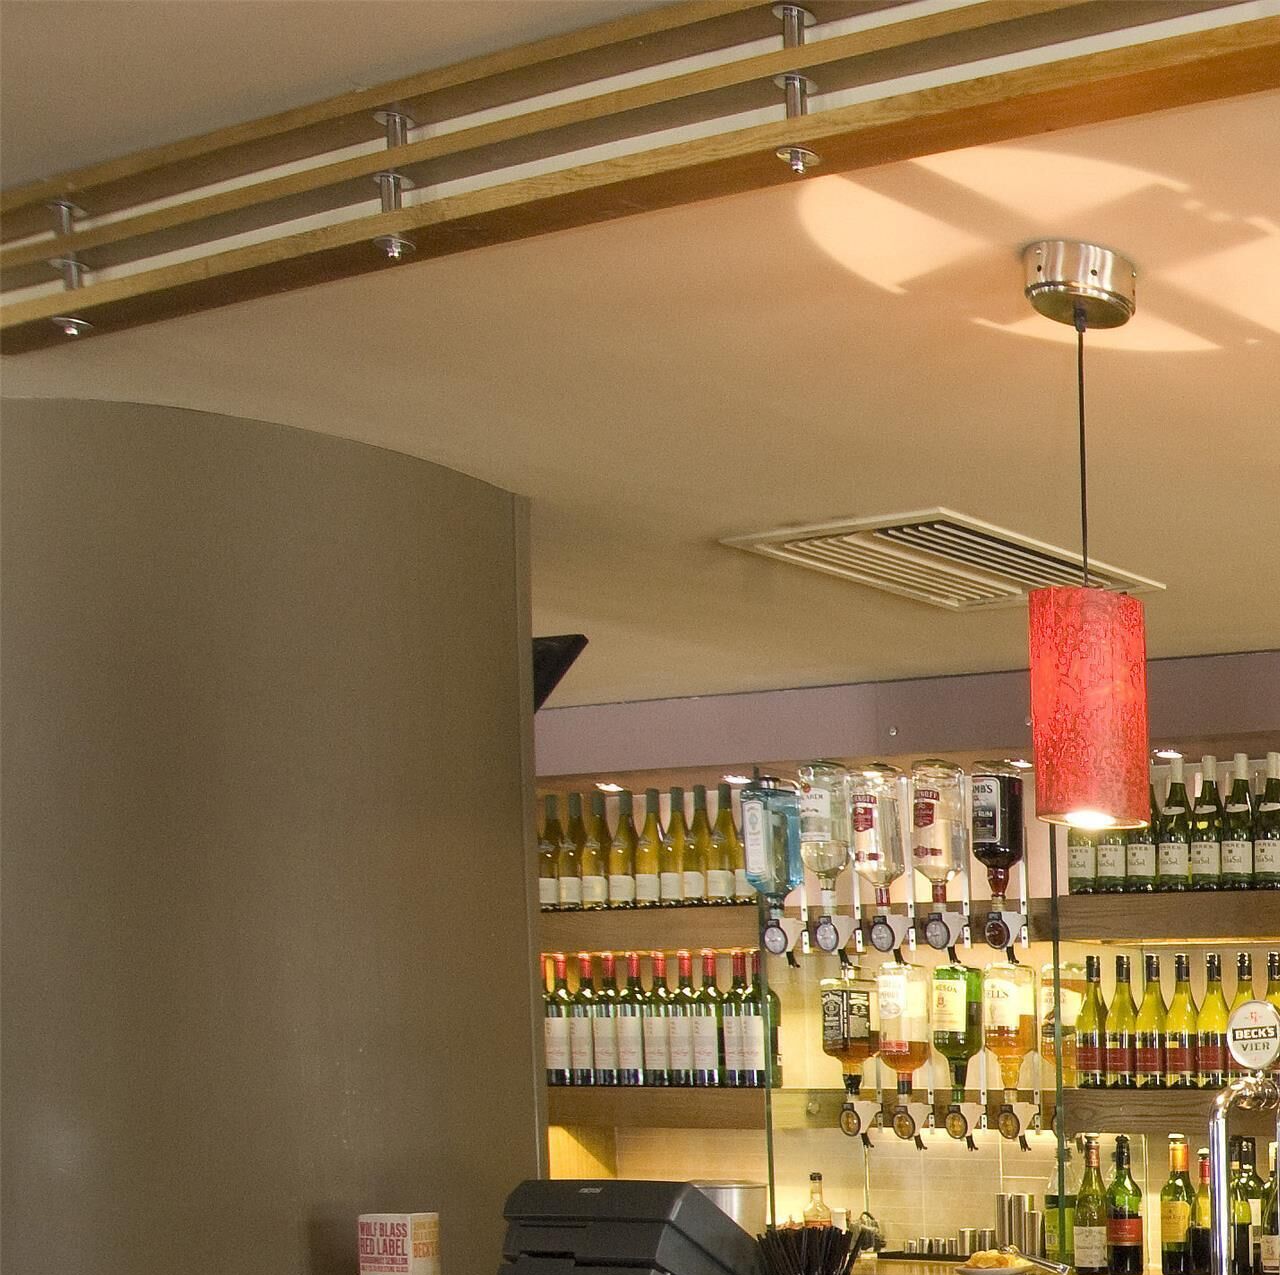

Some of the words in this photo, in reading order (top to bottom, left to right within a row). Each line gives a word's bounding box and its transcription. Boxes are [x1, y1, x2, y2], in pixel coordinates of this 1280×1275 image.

[1234, 1026, 1275, 1040] BECK'S
[1241, 1042, 1270, 1052] VIER
[359, 1221, 378, 1237] WOLF
[379, 1222, 408, 1238] BLASS
[360, 1237, 375, 1256] RED
[377, 1238, 408, 1257] LABEL
